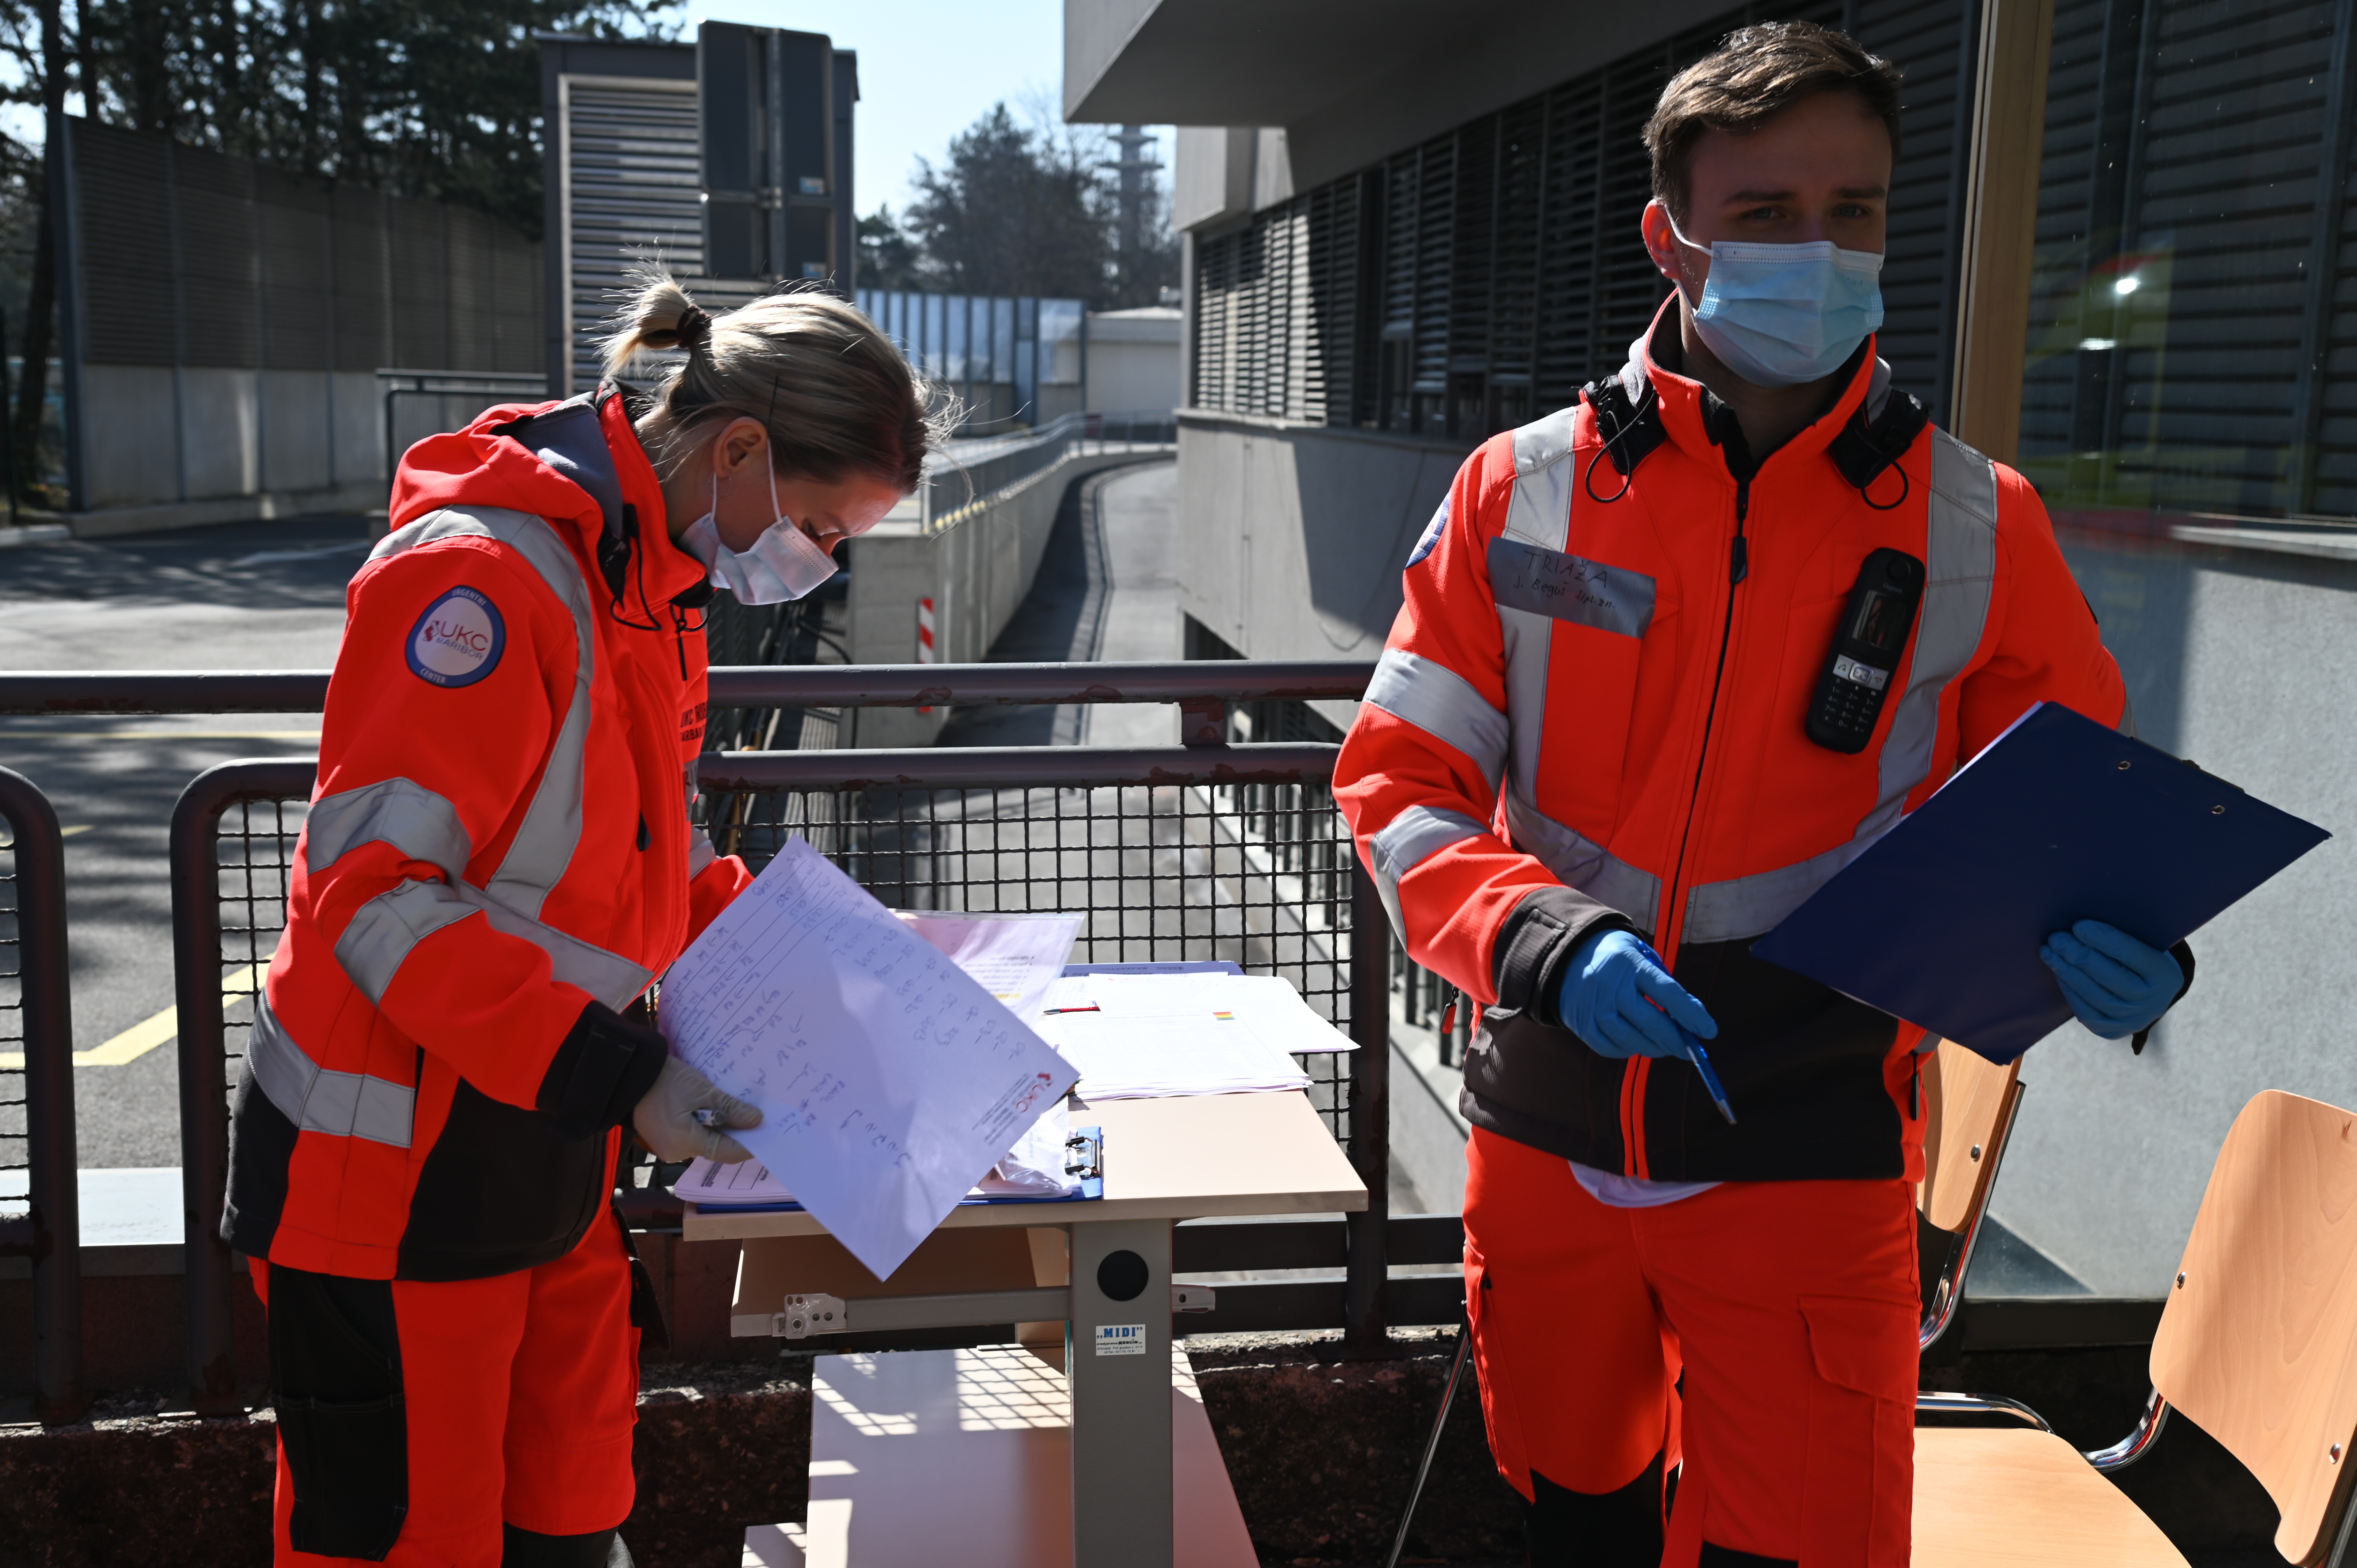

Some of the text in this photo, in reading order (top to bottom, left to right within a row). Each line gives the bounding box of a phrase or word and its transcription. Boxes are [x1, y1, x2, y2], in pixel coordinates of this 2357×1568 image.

[1523, 549, 1608, 588] TRIAŽA
[451, 588, 487, 606] URGENTNI
[435, 637, 484, 661] MARIBOR
[440, 621, 489, 651] UKC
[420, 668, 447, 684] CENTER
[1014, 1079, 1047, 1114] UKC
